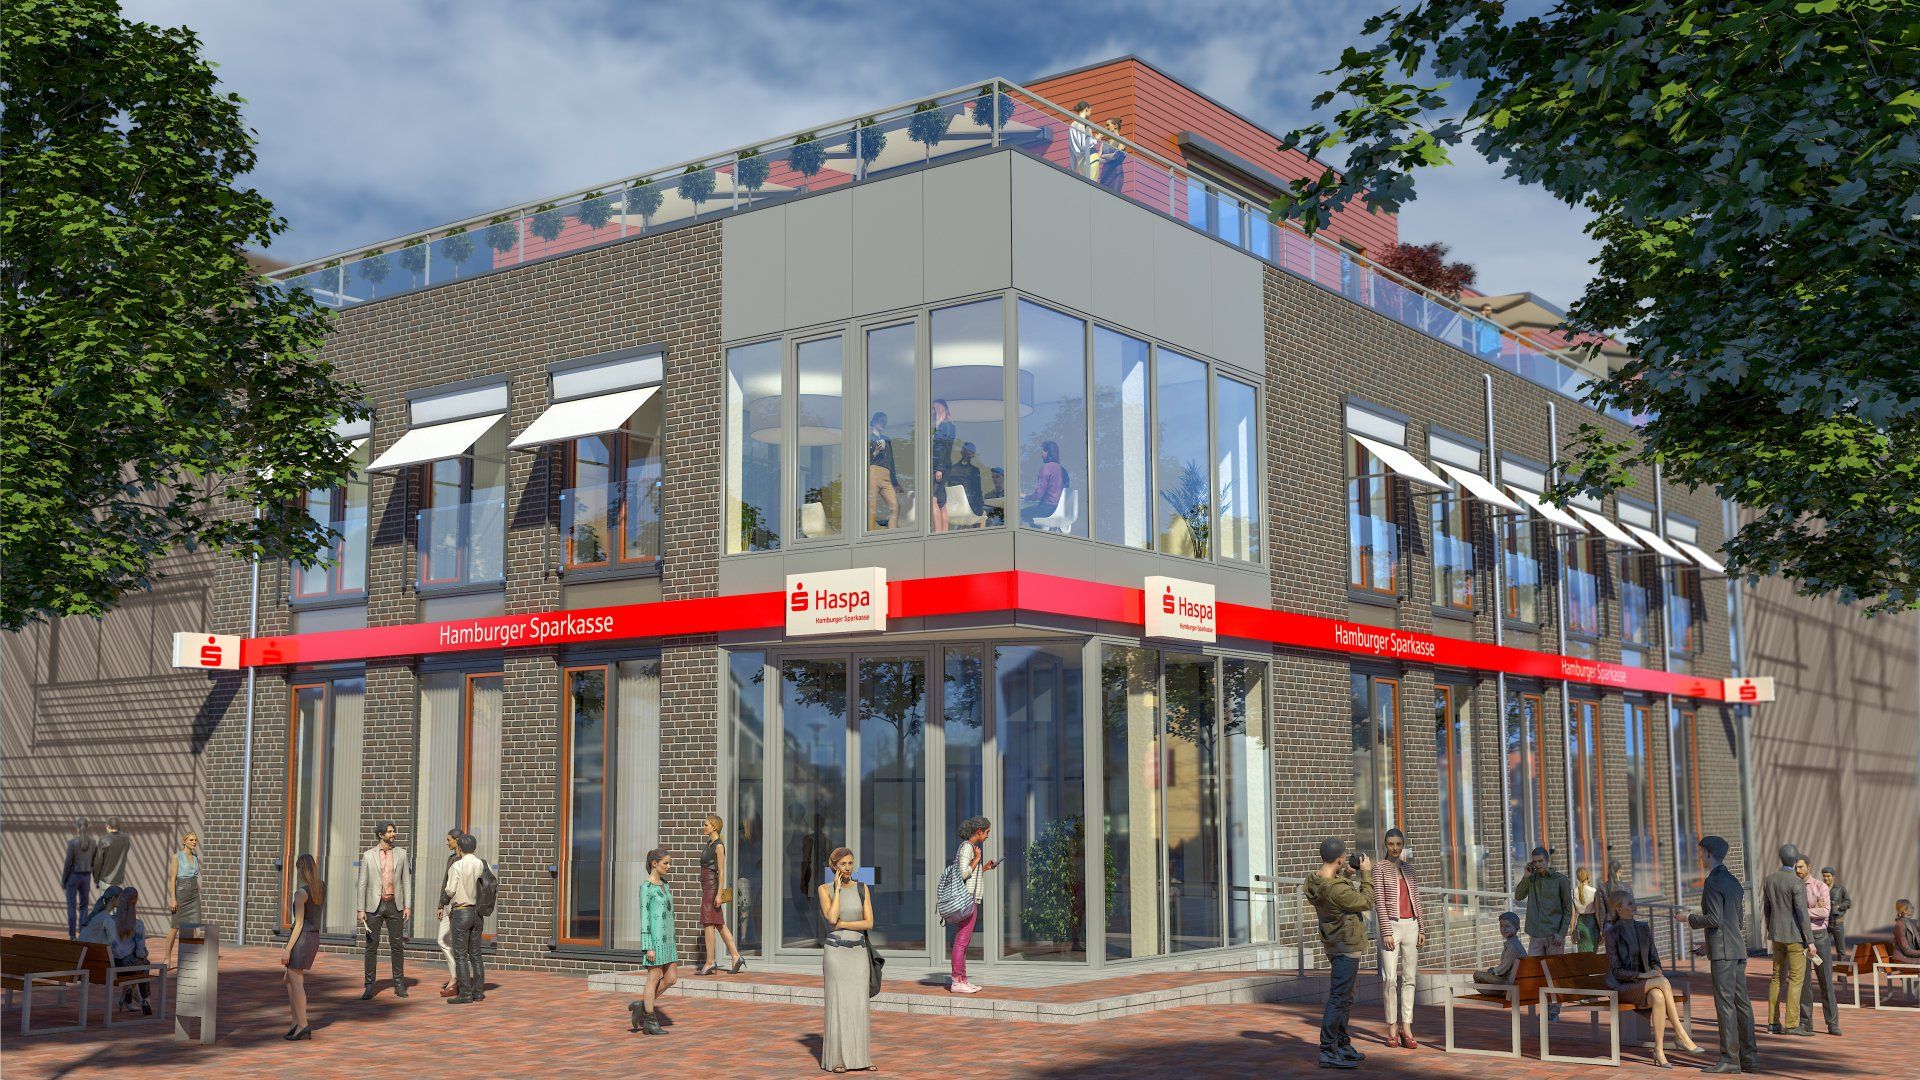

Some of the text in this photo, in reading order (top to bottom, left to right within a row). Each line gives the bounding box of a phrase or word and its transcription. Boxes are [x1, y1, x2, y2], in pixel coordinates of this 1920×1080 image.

[815, 590, 869, 612] Haspa
[1179, 597, 1212, 623] Haspa
[439, 614, 613, 645] Hamburger Sparkasse
[815, 614, 869, 624] Hamburger Sparkasse
[1335, 624, 1435, 656] Hamburger Sparkasse
[1562, 658, 1596, 682] Hamburger
